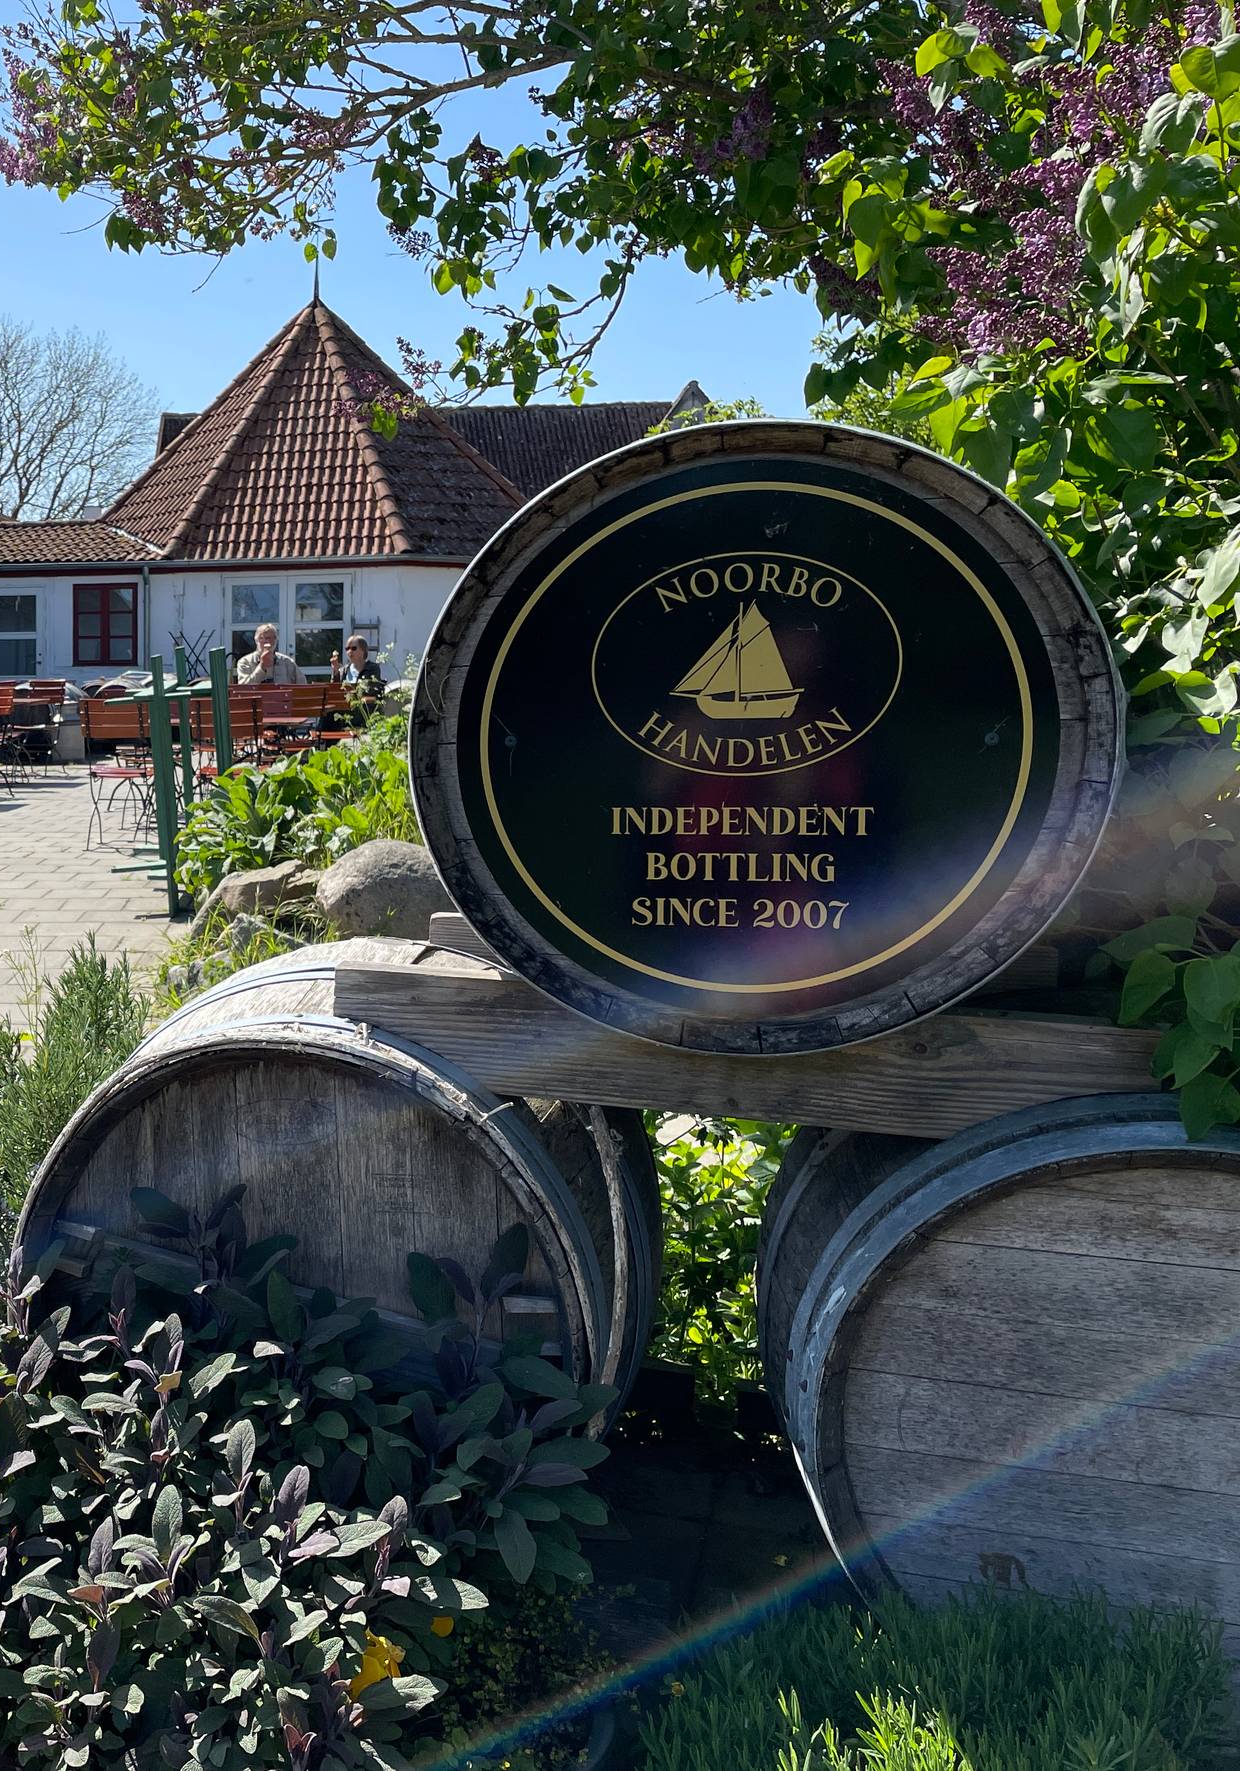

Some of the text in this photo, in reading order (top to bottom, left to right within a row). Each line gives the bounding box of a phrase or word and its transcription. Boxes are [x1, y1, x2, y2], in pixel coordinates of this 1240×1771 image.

[654, 562, 842, 613] NOORBO
[637, 706, 852, 768] HANDELEN
[611, 806, 875, 836] INDEPENDENT
[646, 852, 835, 882] BOTTLING
[631, 897, 849, 930] SINCE 2007
